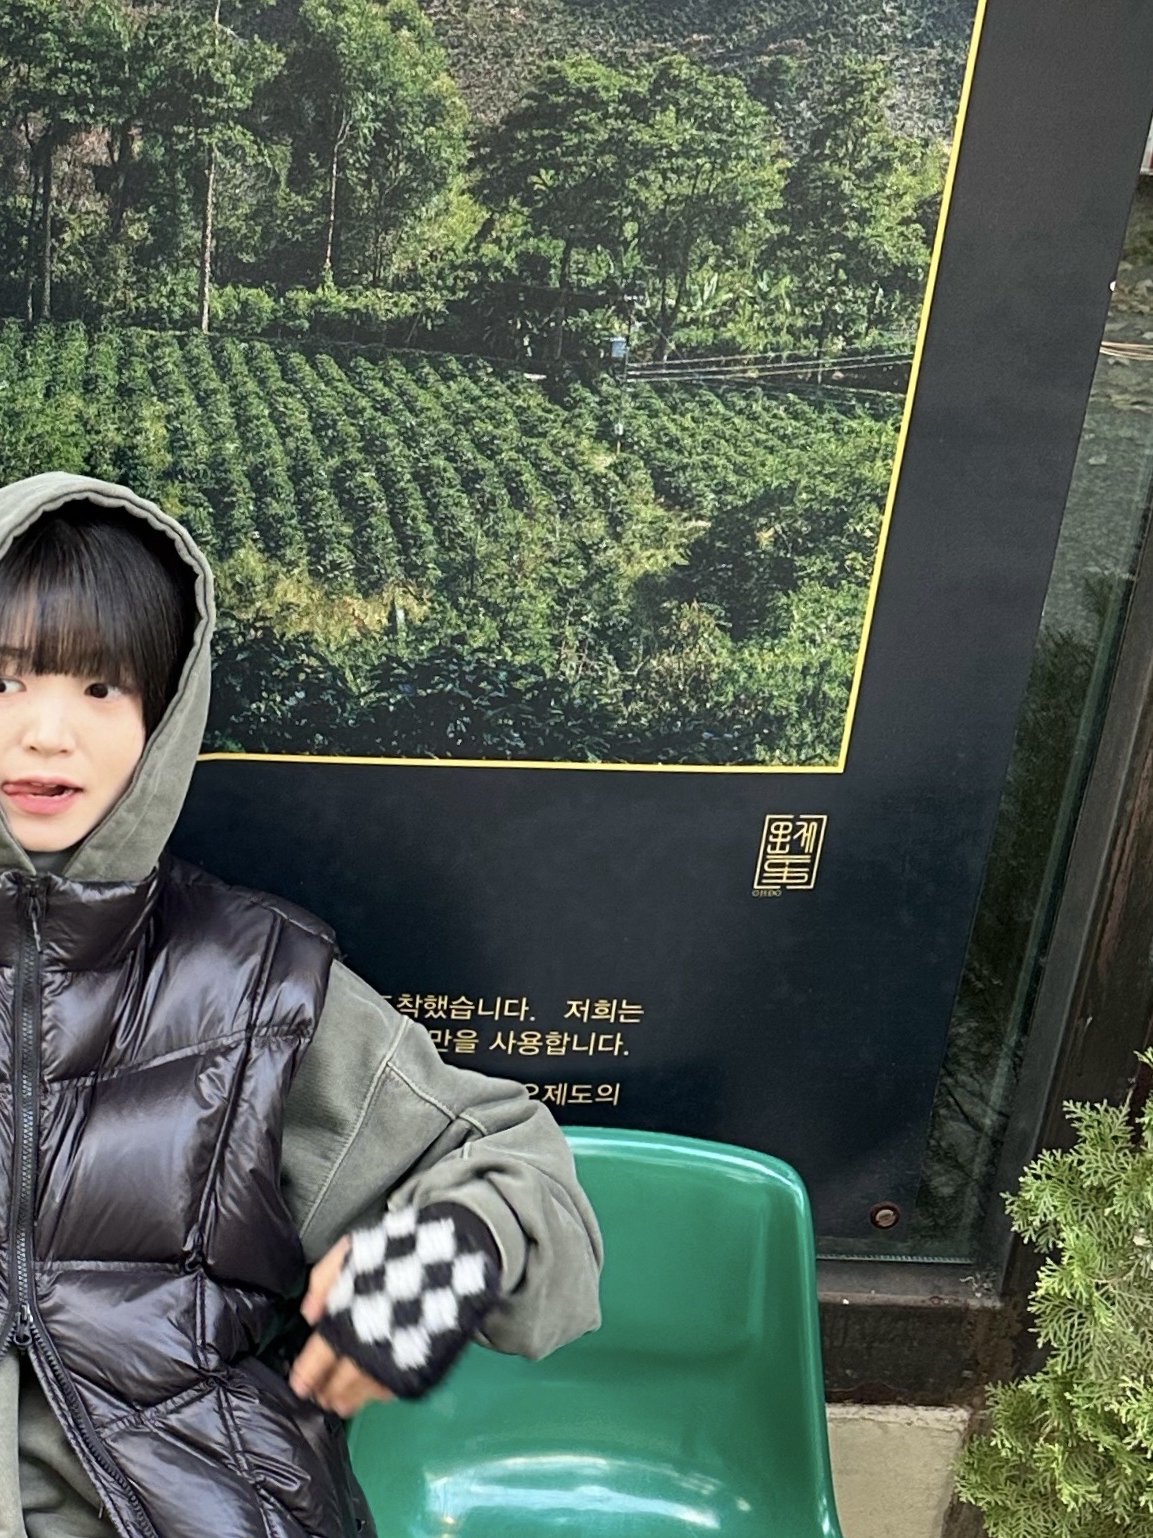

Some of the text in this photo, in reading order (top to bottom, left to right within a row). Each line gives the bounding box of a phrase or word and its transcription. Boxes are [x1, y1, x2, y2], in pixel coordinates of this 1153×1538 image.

[382, 993, 645, 1024] 착했습니다. 저희는
[488, 1030, 630, 1057] 사용합니다.
